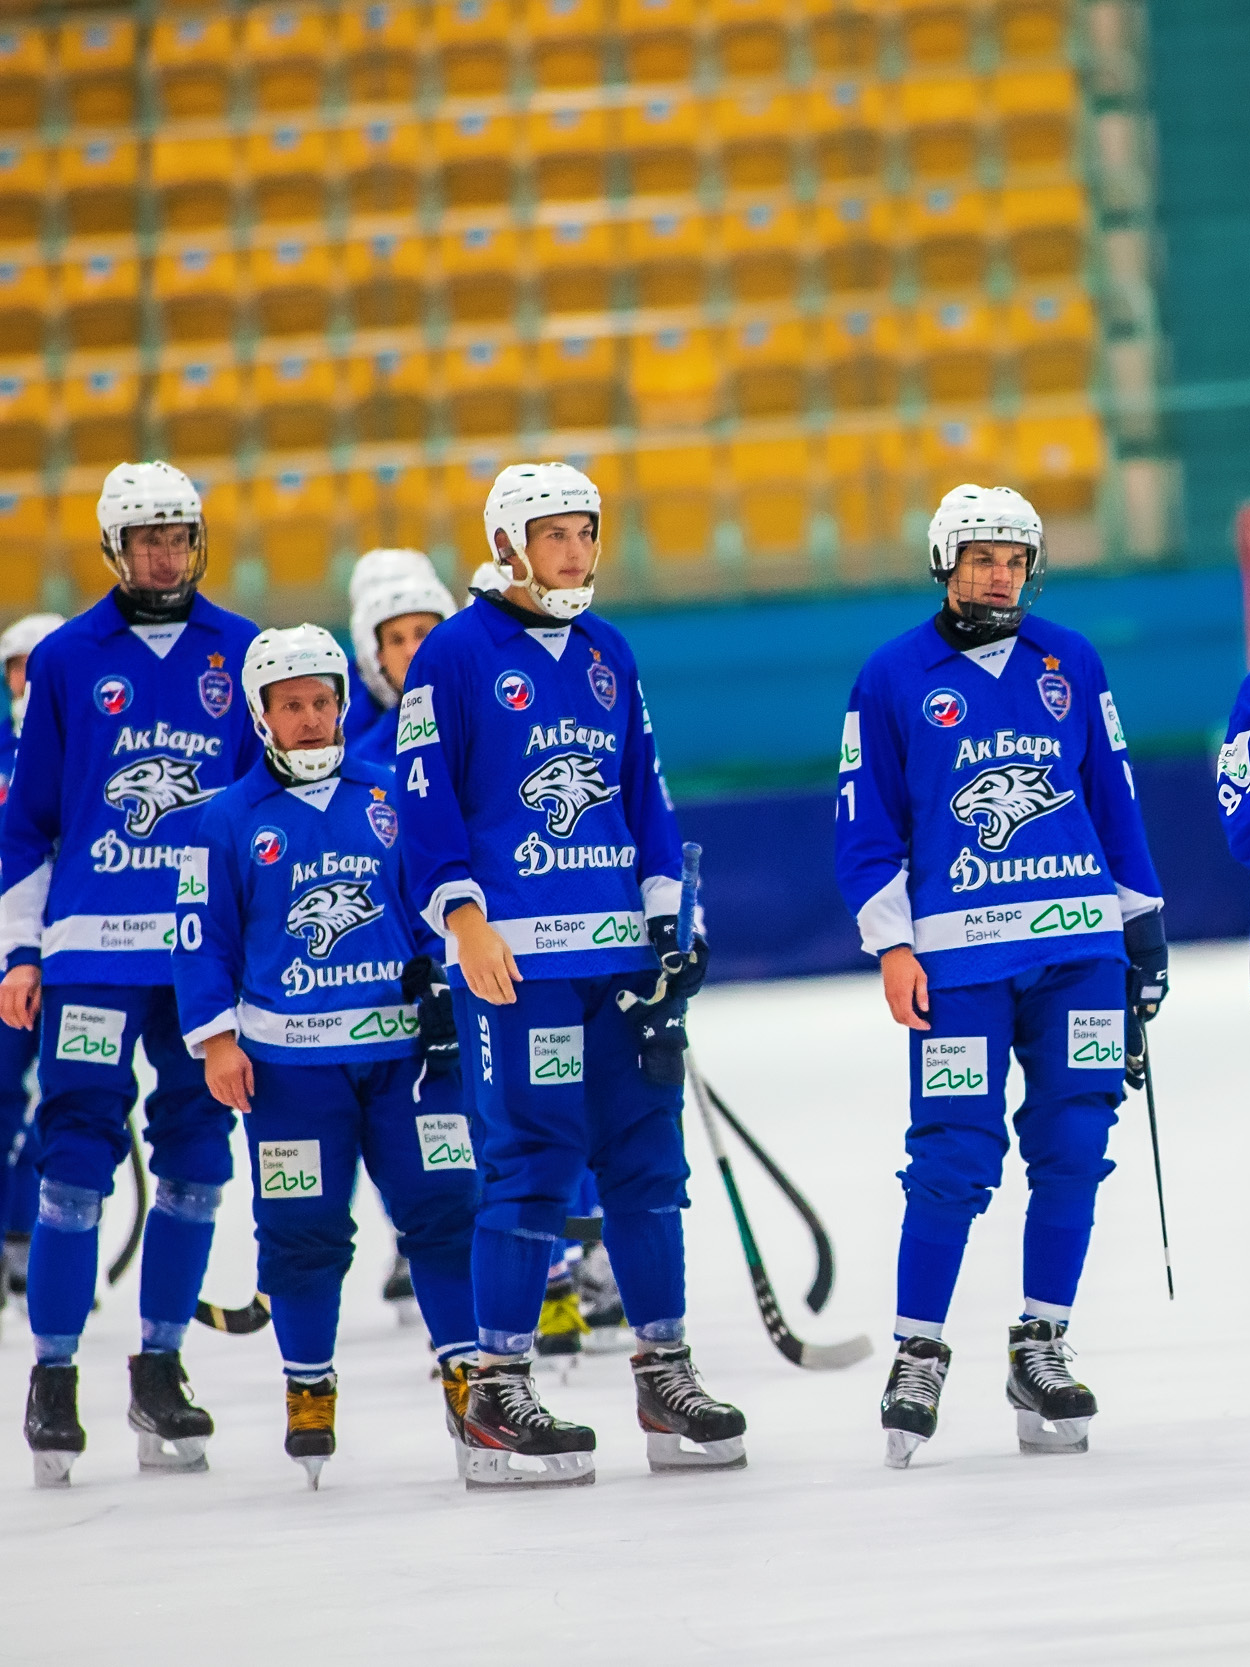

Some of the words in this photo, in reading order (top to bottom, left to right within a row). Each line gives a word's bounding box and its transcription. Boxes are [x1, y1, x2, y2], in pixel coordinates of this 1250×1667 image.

[113, 726, 150, 756] Ак
[153, 721, 222, 758] Барс
[525, 723, 560, 757] Ак
[560, 718, 616, 753] Барс
[953, 738, 991, 771] Ак
[996, 729, 1060, 762] Барс
[407, 757, 429, 798] 4
[291, 863, 318, 891] Ак
[322, 852, 380, 878] Барс
[950, 847, 1101, 892] Динамо
[964, 914, 983, 926] Ак
[987, 909, 1022, 923] Барс
[101, 920, 119, 931] Ак
[123, 919, 156, 932] Барс
[534, 921, 553, 932] Ак
[554, 920, 585, 933] Барс
[101, 936, 134, 947] Банк
[966, 929, 1001, 943] Банк
[536, 937, 568, 948] Банк
[285, 1018, 304, 1029] Ак
[308, 1016, 342, 1028] Барс
[1074, 1017, 1087, 1026] Ак
[1089, 1017, 1112, 1028] Барс
[286, 1033, 320, 1044] Банк
[534, 1035, 547, 1043] Ак
[550, 1034, 570, 1044] Барс
[1073, 1029, 1098, 1039] Банк
[477, 1014, 493, 1085] STEX
[534, 1047, 558, 1056] Банк
[926, 1046, 939, 1054] Ак
[940, 1045, 966, 1055] Барс
[926, 1057, 949, 1067] Банк
[423, 1121, 437, 1130] Ак
[437, 1120, 457, 1131] Барс
[424, 1133, 446, 1143] Банк
[262, 1149, 273, 1157] Ак
[275, 1147, 298, 1158] Барс
[263, 1160, 284, 1169] Банк
